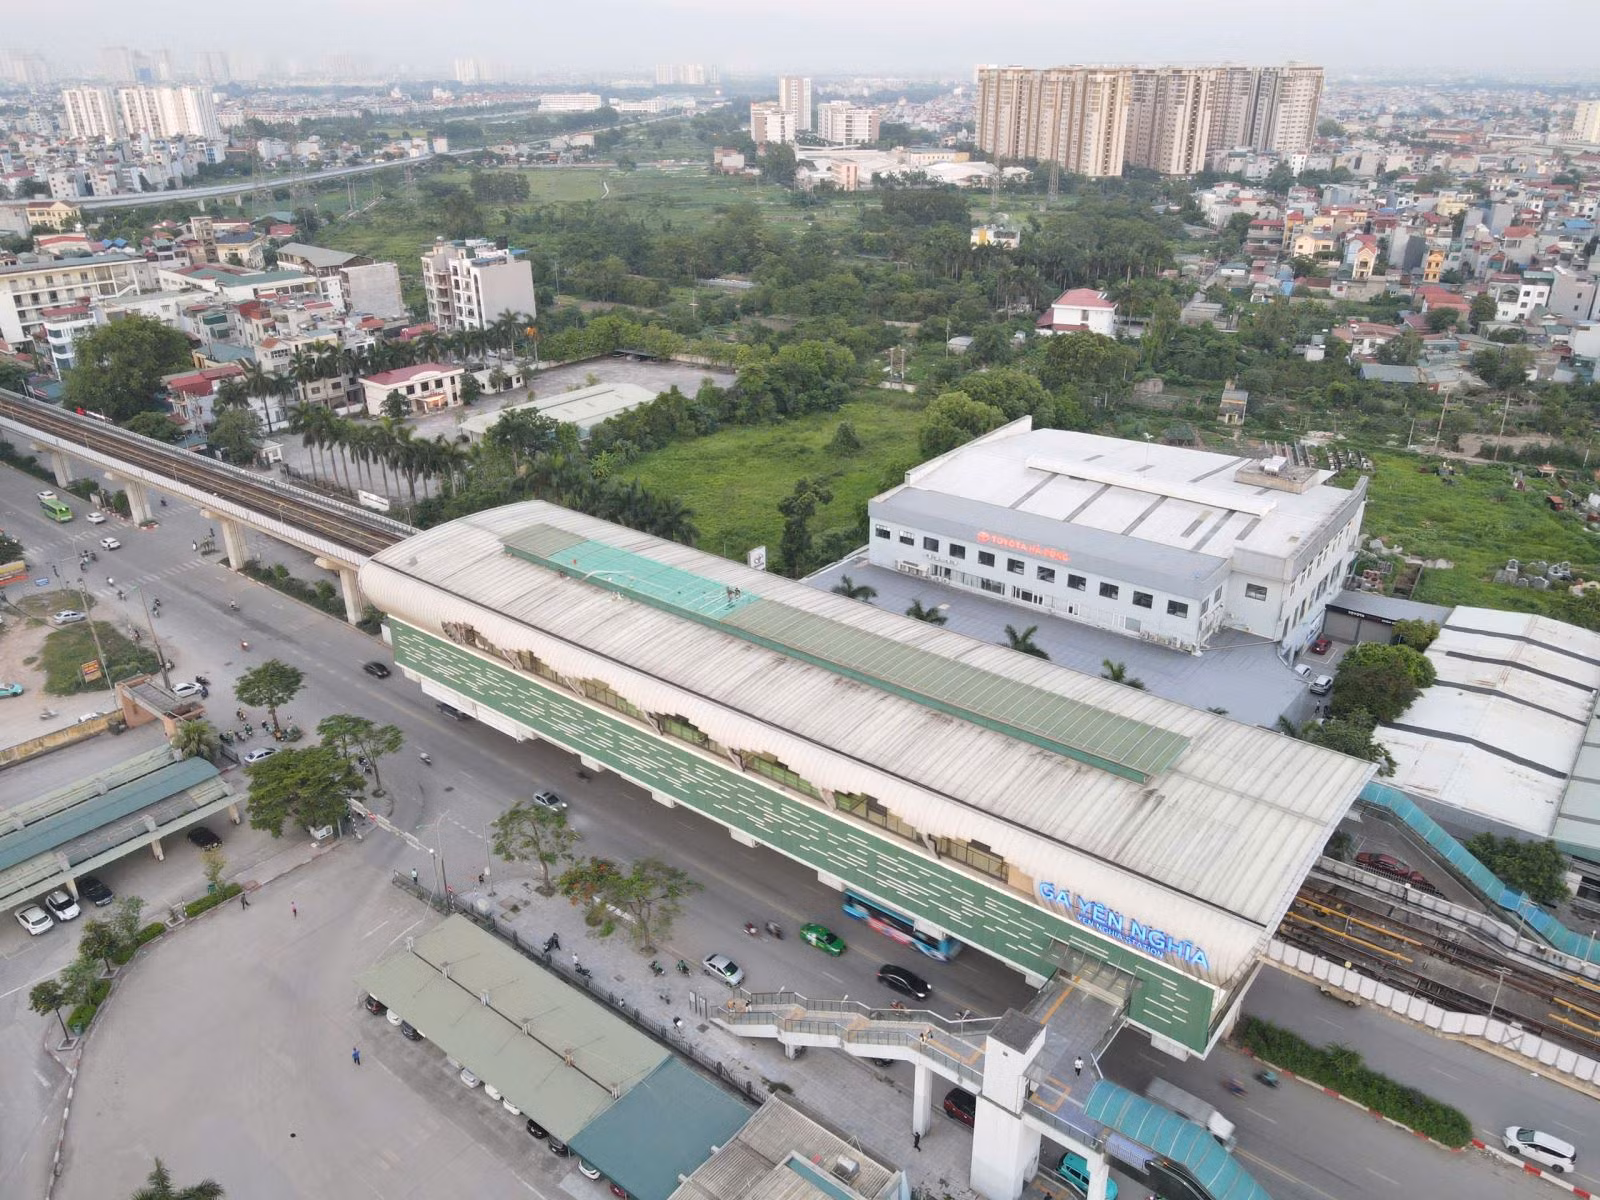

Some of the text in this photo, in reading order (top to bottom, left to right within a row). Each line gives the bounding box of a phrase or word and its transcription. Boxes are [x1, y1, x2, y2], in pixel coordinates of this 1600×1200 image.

[991, 535, 1027, 551] TOYOTA
[1040, 881, 1210, 970] GA YÊN NGHĨA
[1124, 936, 1164, 959] STATION
